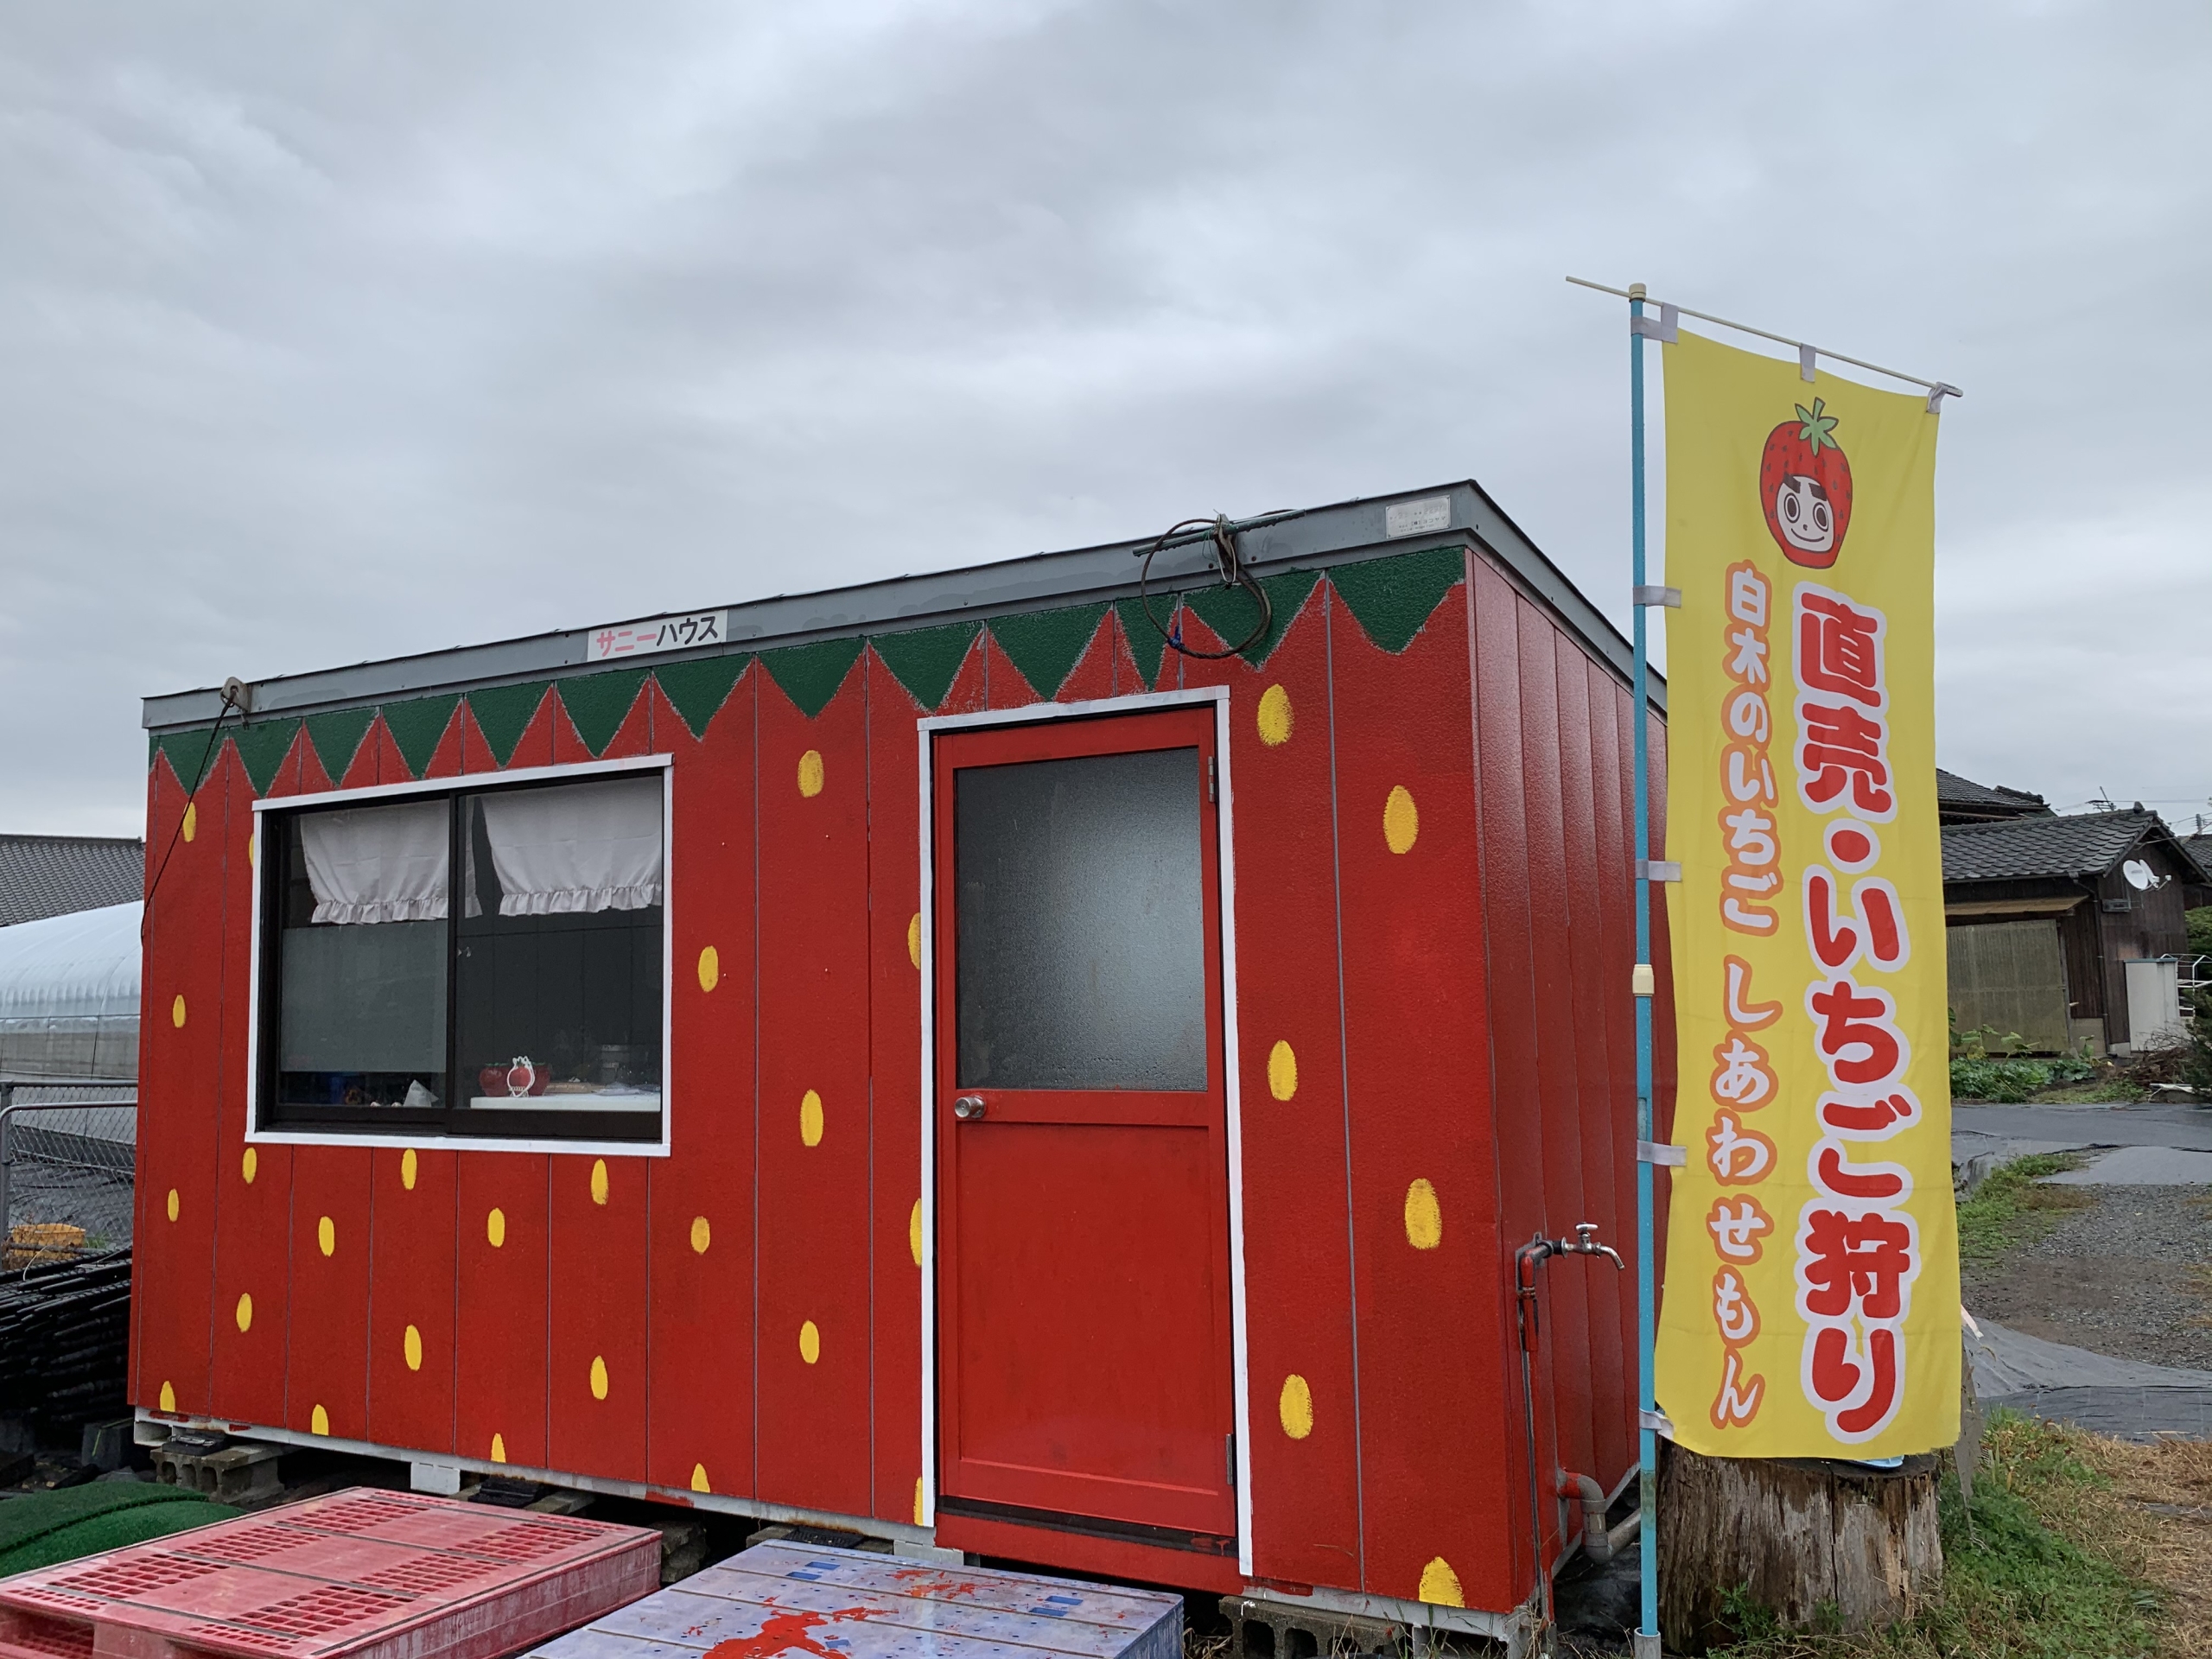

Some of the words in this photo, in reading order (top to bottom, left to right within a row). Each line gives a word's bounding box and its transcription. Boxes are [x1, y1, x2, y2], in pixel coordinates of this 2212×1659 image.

[596, 615, 719, 657] サニーハウス
